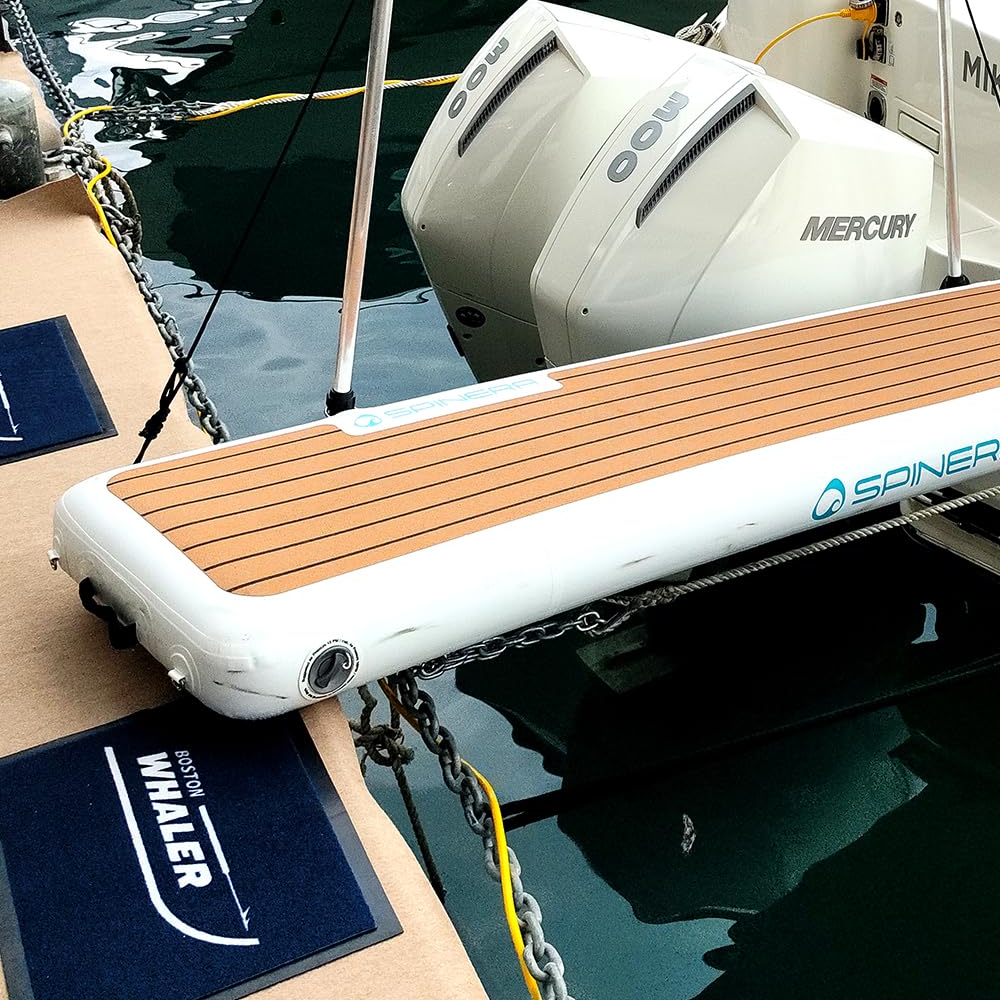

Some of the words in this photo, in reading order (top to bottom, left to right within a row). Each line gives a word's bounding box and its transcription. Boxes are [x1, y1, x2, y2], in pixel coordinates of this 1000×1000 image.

[448, 36, 510, 120] 300
[606, 91, 690, 183] 300
[799, 213, 917, 242] MERCURY
[384, 378, 539, 419] SPINERA
[174, 750, 205, 798] BOSTON
[136, 751, 213, 889] WHALER
